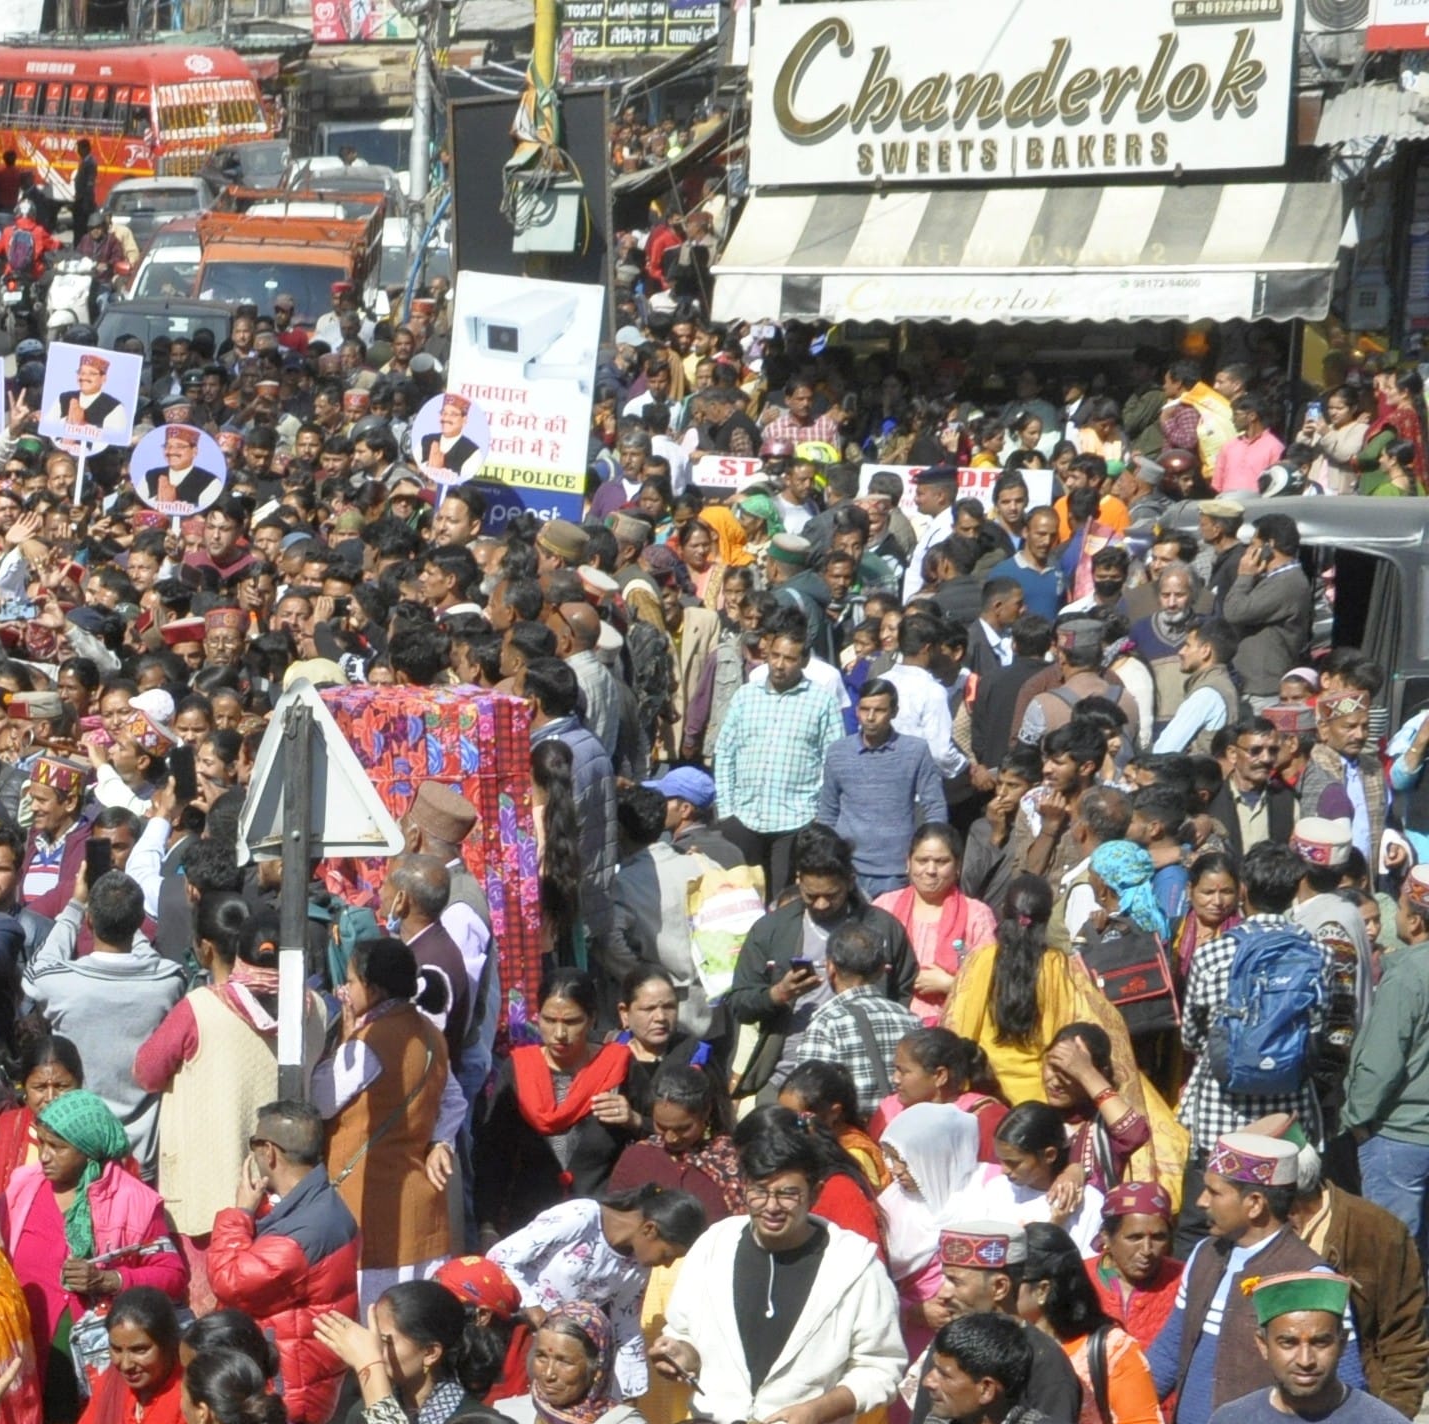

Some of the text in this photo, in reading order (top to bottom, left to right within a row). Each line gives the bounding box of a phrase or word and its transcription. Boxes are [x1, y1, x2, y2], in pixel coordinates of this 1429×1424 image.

[773, 17, 1267, 142] Chanderlok
[857, 132, 1169, 174] SWEETS BAKERS
[847, 279, 1062, 312] Chanderlok
[461, 383, 528, 404] सावधान
[500, 411, 539, 431] कैमरे
[544, 415, 568, 434] की
[550, 443, 561, 463] है
[511, 468, 576, 489] POLICE
